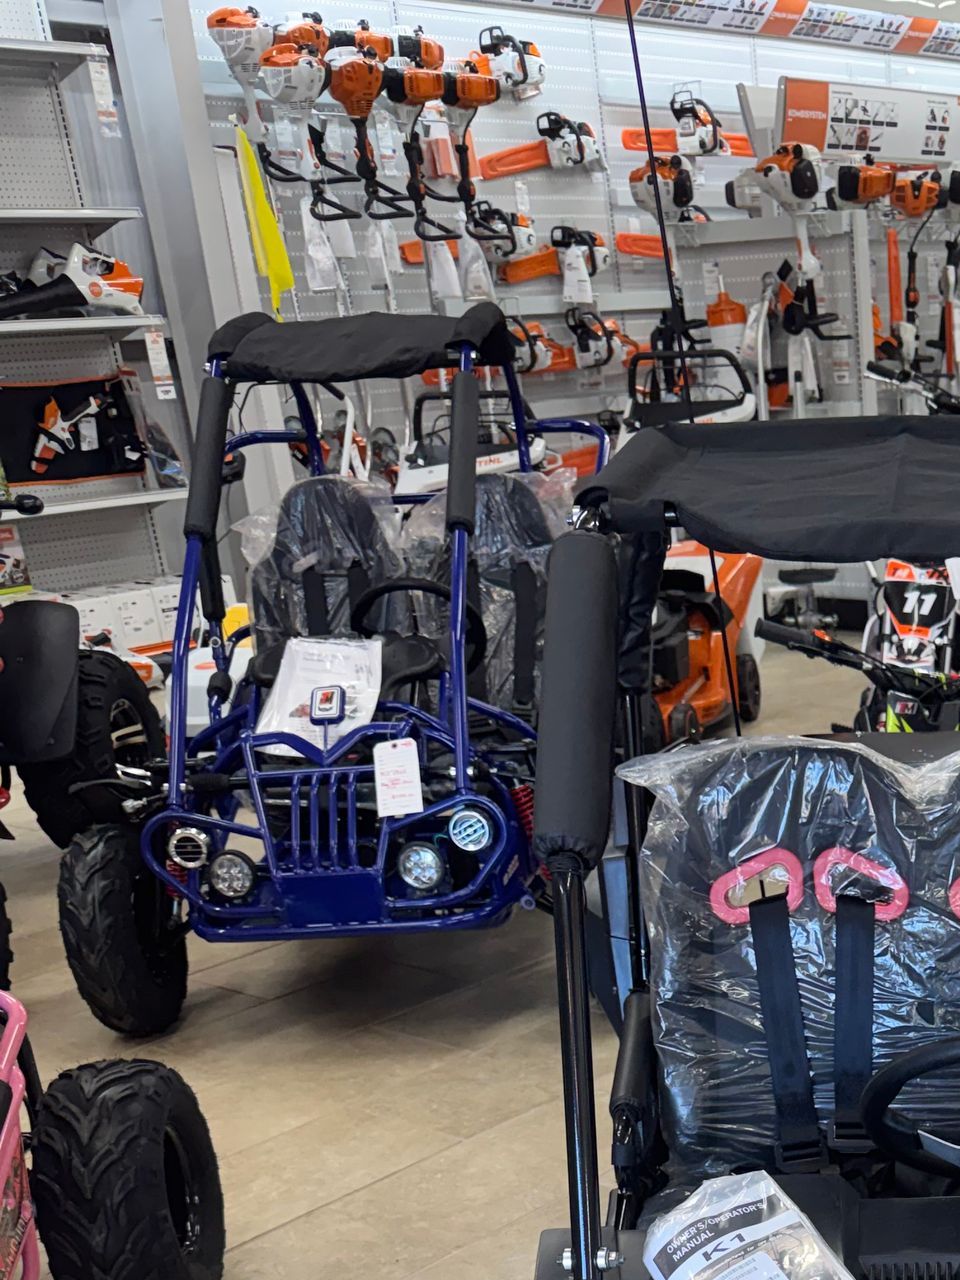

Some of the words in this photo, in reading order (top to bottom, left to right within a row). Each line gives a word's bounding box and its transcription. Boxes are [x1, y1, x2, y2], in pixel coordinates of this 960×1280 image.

[902, 591, 937, 615] 11
[667, 1201, 765, 1254] OWNER'S/OPERATOR'S
[672, 1231, 714, 1262] MANUAL
[702, 1232, 747, 1262] K1
